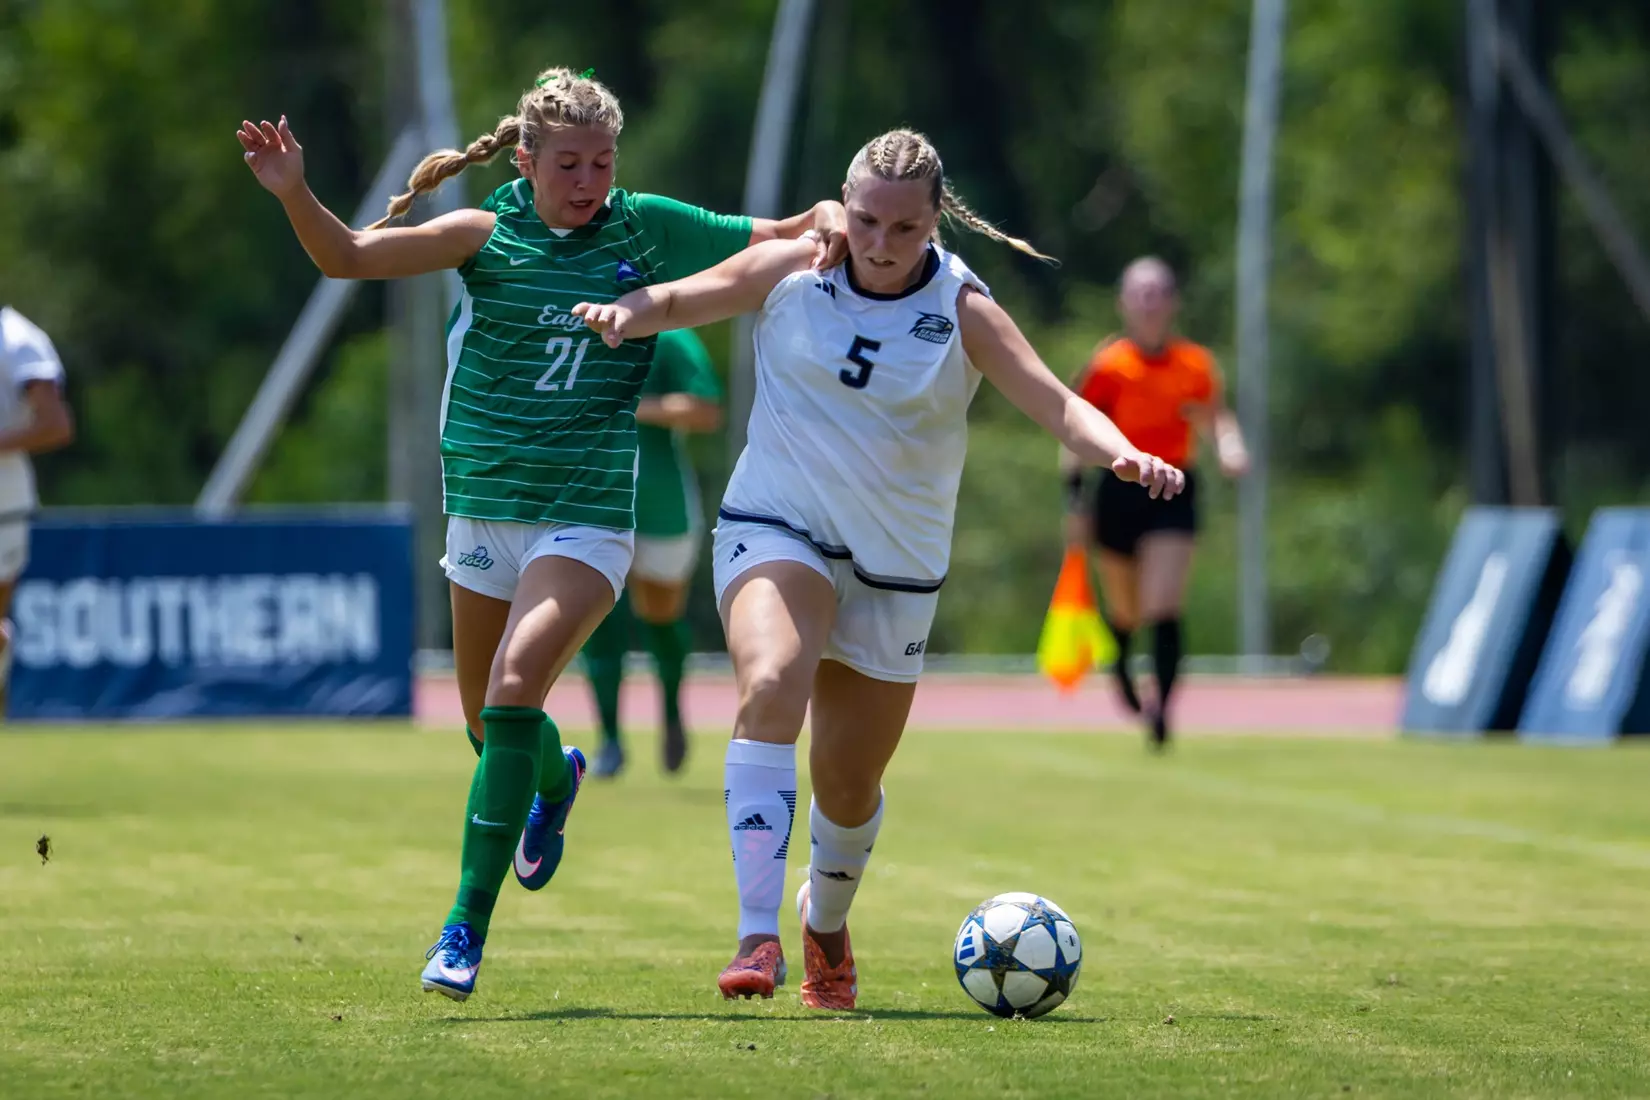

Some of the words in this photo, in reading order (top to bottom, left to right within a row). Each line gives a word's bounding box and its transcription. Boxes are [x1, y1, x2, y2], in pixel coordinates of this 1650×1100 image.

[537, 304, 588, 332] Eag
[534, 337, 591, 391] 21
[839, 335, 882, 389] 5
[15, 575, 378, 666] SOUTHERN
